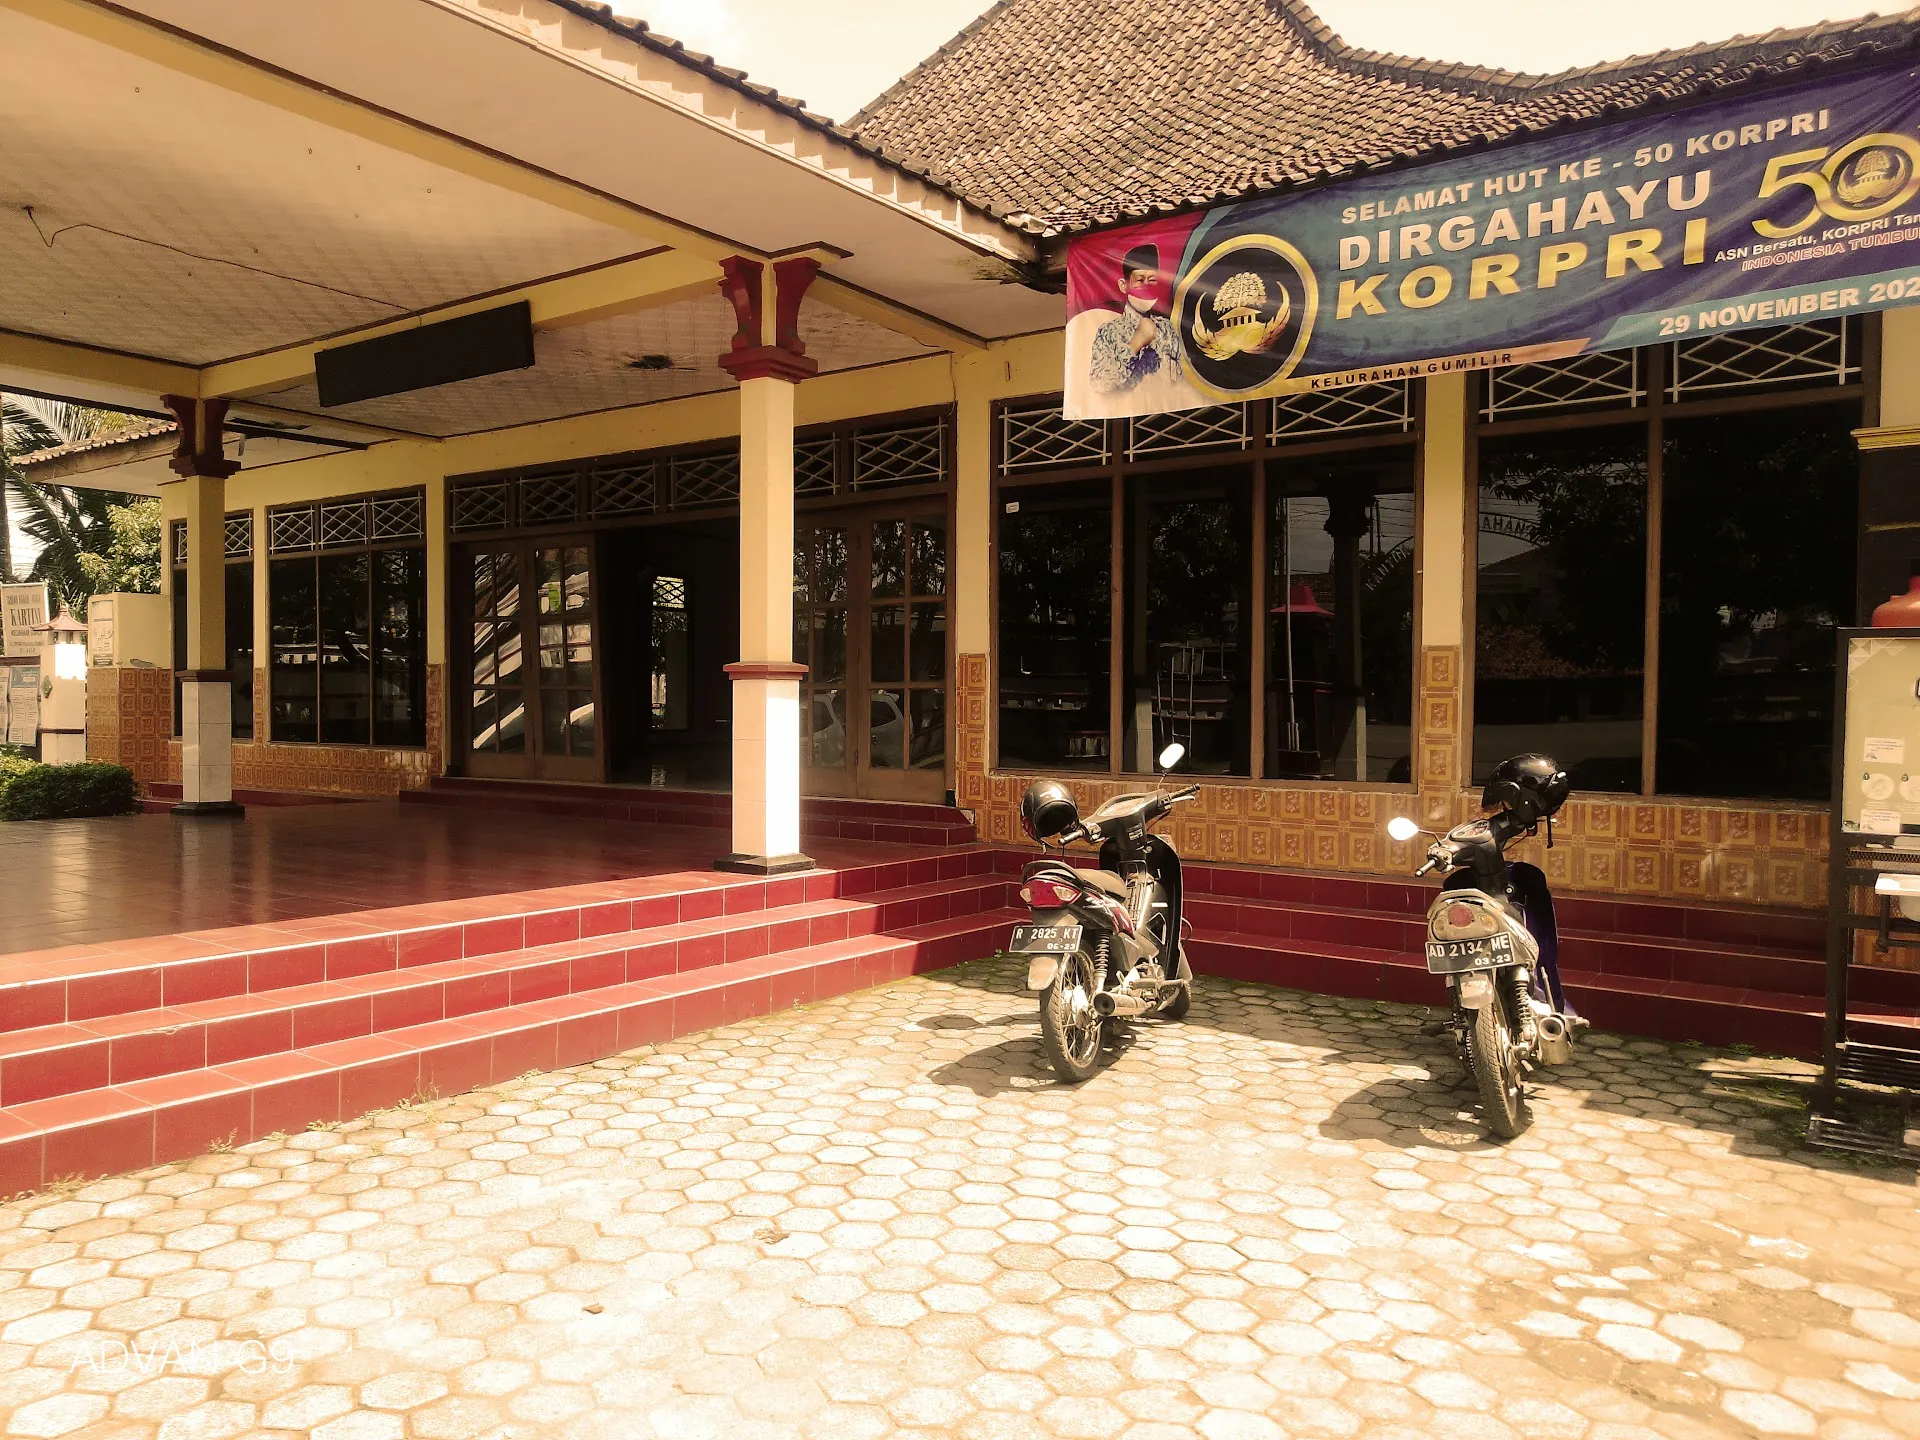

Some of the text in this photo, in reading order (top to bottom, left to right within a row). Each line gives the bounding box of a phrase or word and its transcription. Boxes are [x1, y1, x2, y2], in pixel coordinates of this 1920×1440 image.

[1341, 182, 1474, 225] SELAMAT
[1483, 167, 1548, 198] HUT
[1559, 157, 1602, 184] KE
[1633, 143, 1673, 168] 50
[1686, 109, 1829, 157] KORPRI
[1339, 169, 1711, 271] DIRGAHAYU
[1714, 247, 1748, 263] ASN
[1752, 234, 1817, 256] Bersatu,
[1822, 217, 1889, 242] KORPRI
[1335, 218, 1708, 320] KORPRI
[1741, 227, 1920, 272] INDONESIA TUMBU
[1658, 315, 1691, 337] 29
[1698, 287, 1860, 330] NOVEMBER
[1311, 353, 1512, 389] KELURAHAN GUMILIR
[1015, 928, 1079, 940] R 2825 KT
[1428, 935, 1510, 958] AD 2134 ME
